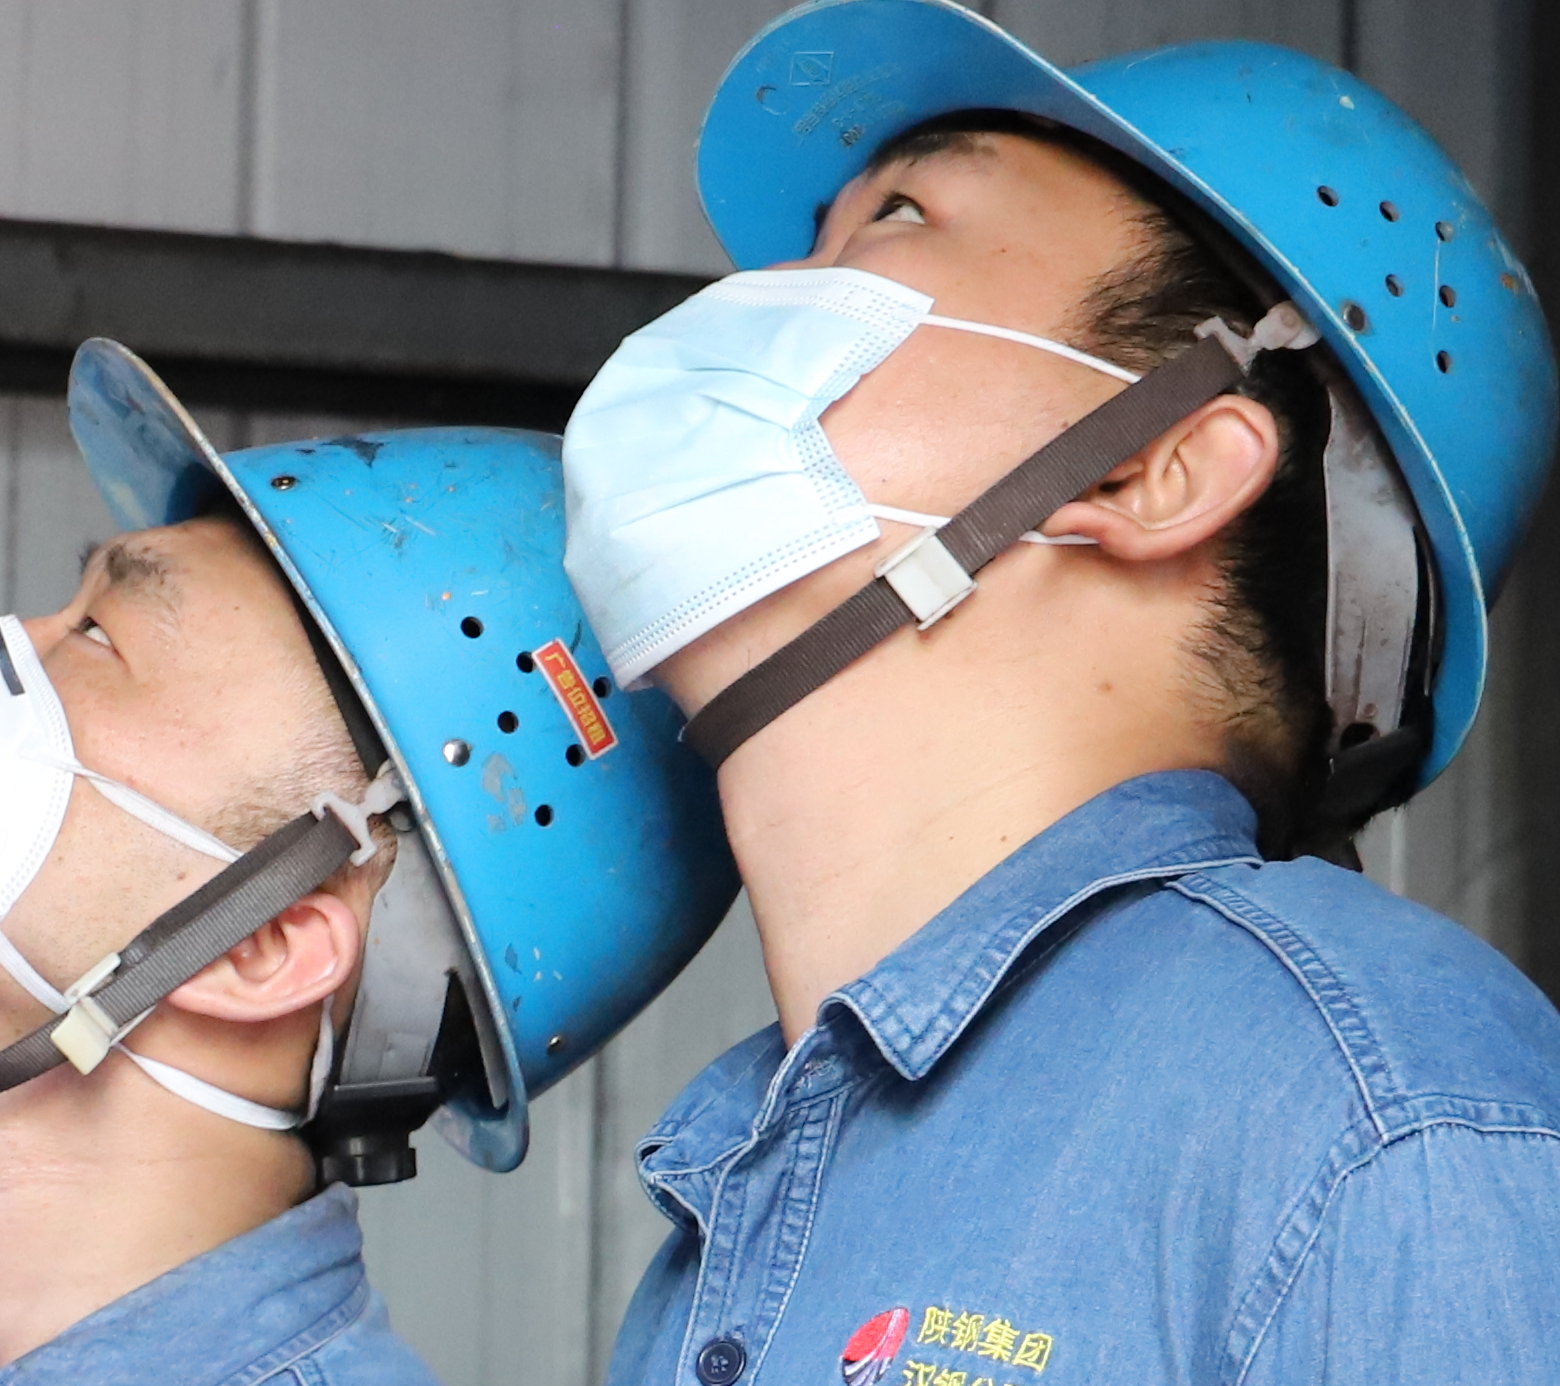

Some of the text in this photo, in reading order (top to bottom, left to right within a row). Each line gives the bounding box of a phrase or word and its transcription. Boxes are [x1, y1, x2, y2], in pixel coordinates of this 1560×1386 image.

[544, 652, 607, 746] 广告位招租
[917, 1306, 1054, 1372] 陕钢集团
